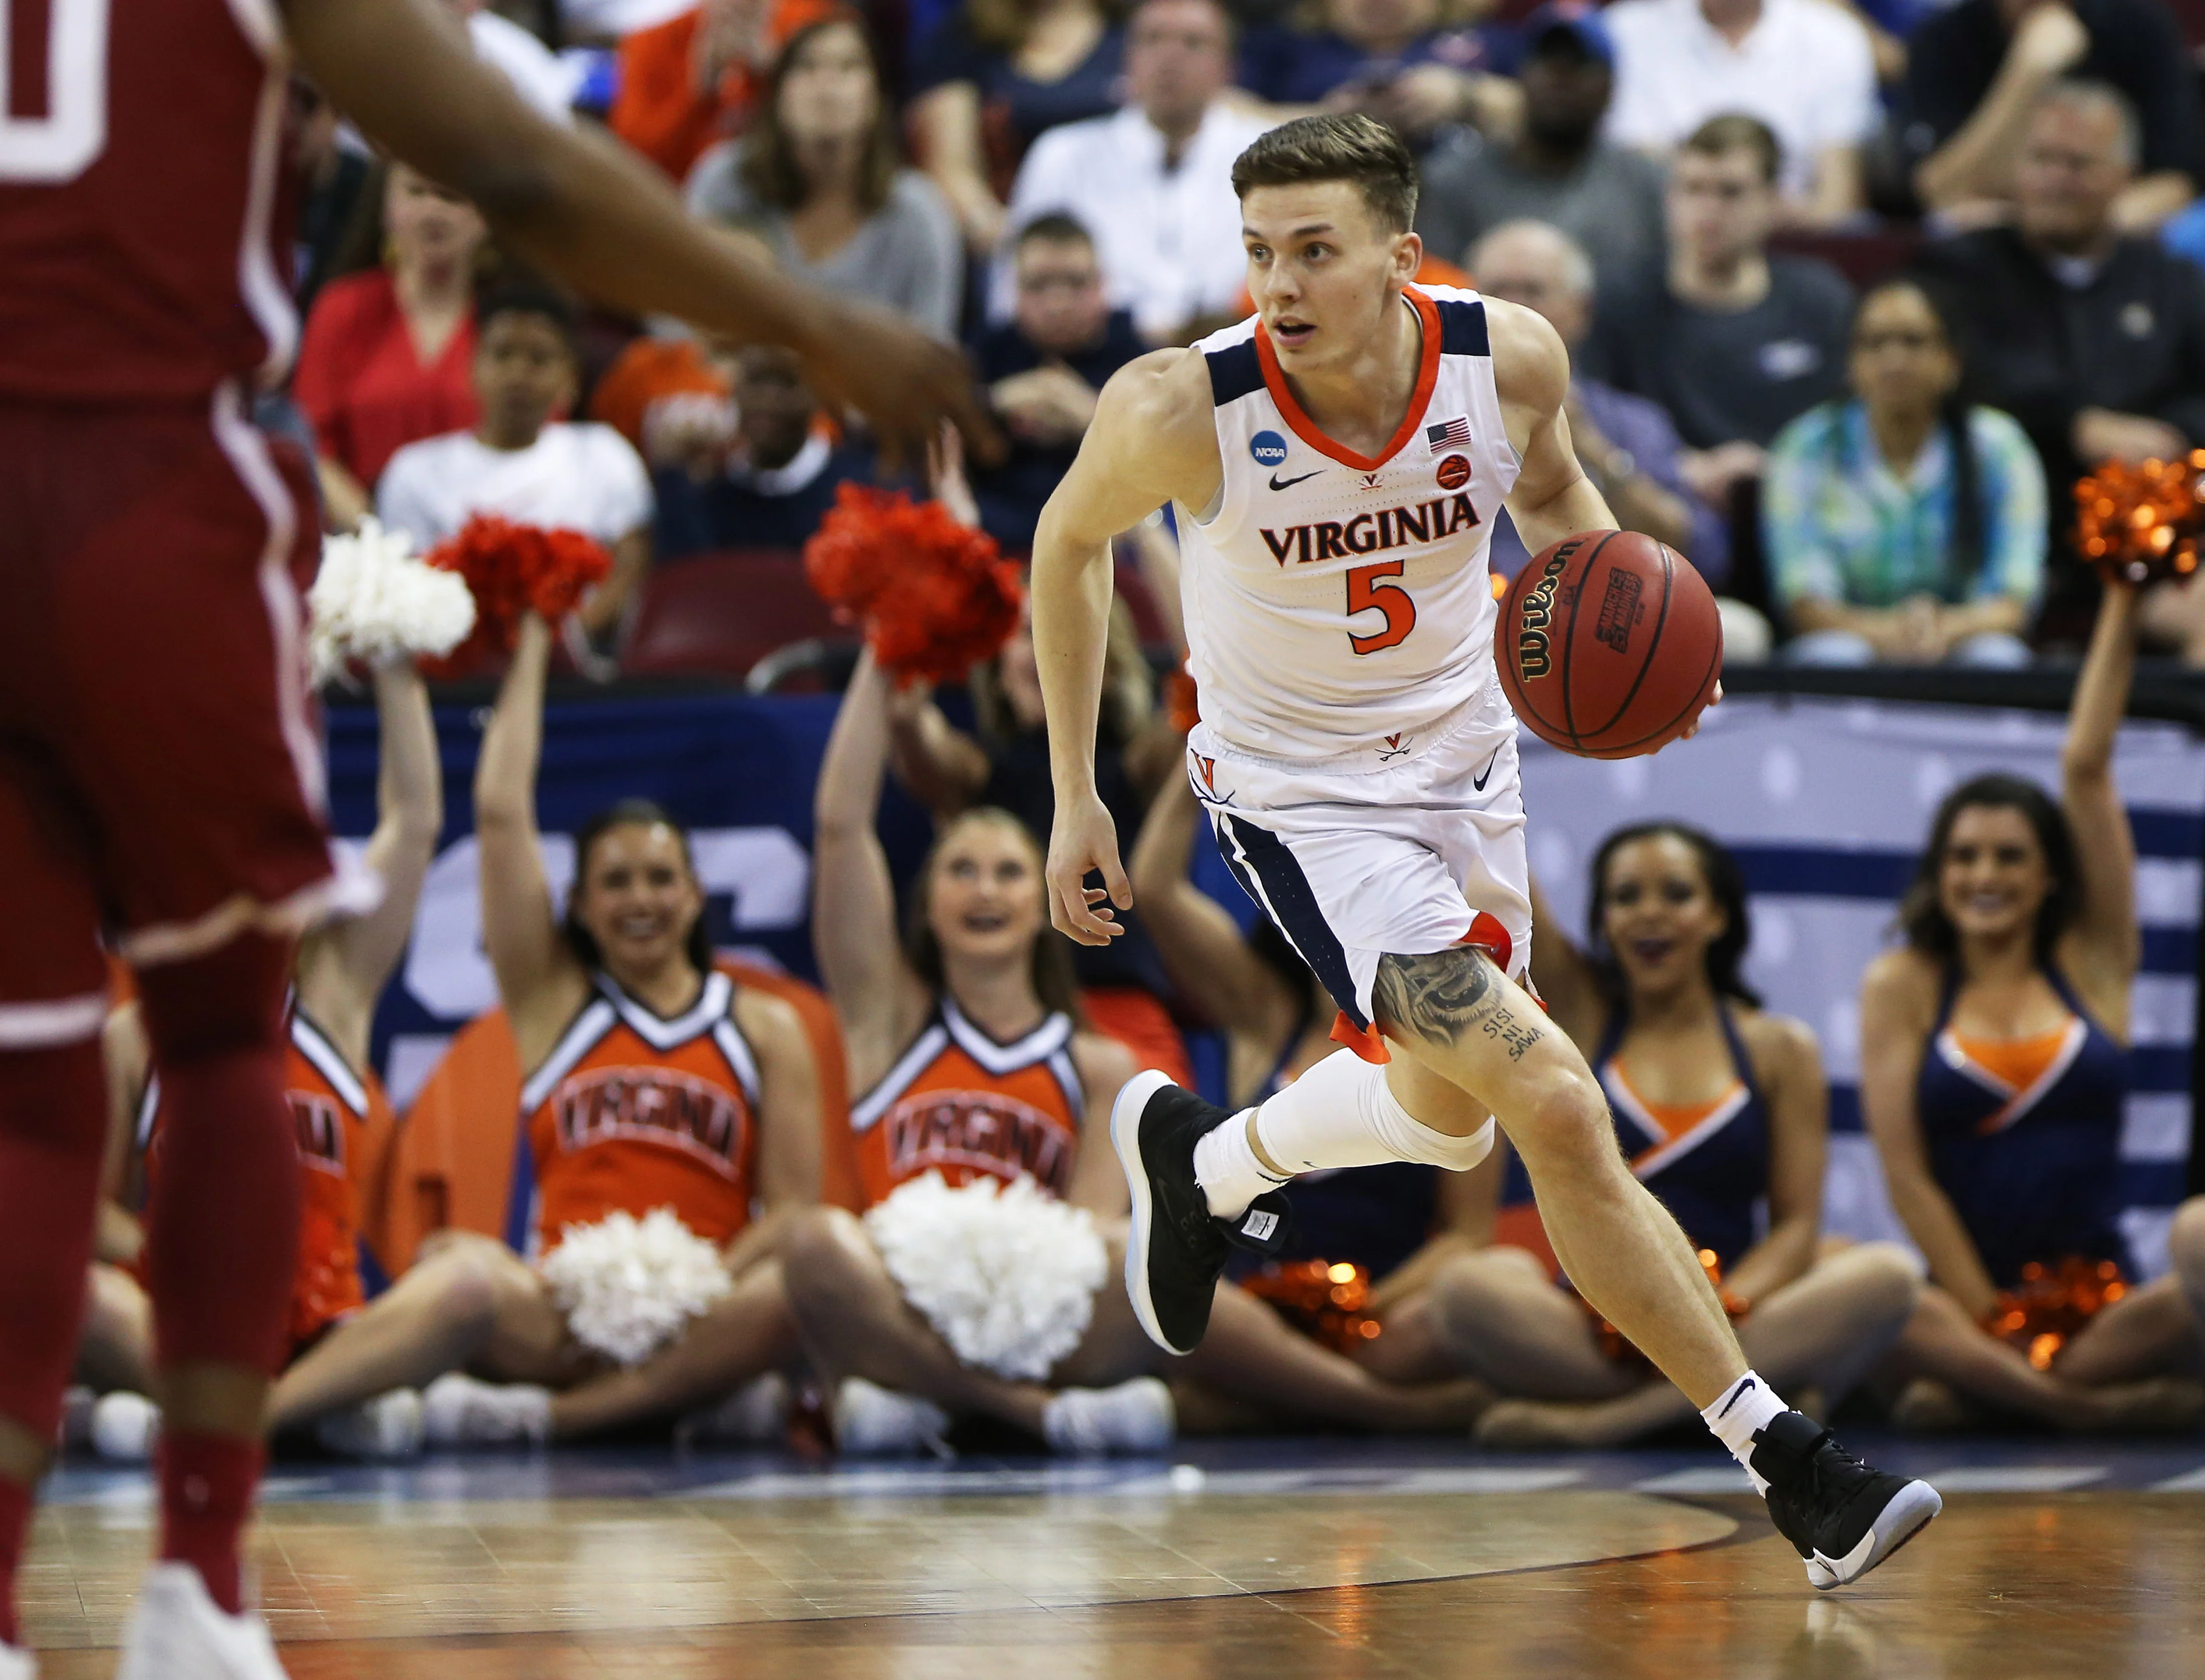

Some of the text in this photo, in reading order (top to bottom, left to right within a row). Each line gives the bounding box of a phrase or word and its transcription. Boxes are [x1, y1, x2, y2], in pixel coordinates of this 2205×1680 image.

[1255, 448, 1285, 458] NCAA
[1259, 492, 1481, 568] VIRGINIA
[1345, 559, 1416, 655] 5
[1519, 541, 1585, 682] Wilson
[1599, 585, 1621, 626] MARCH
[1483, 1008, 1514, 1039] SISI
[1502, 1024, 1522, 1042] NI
[1509, 1027, 1545, 1062] SAWA
